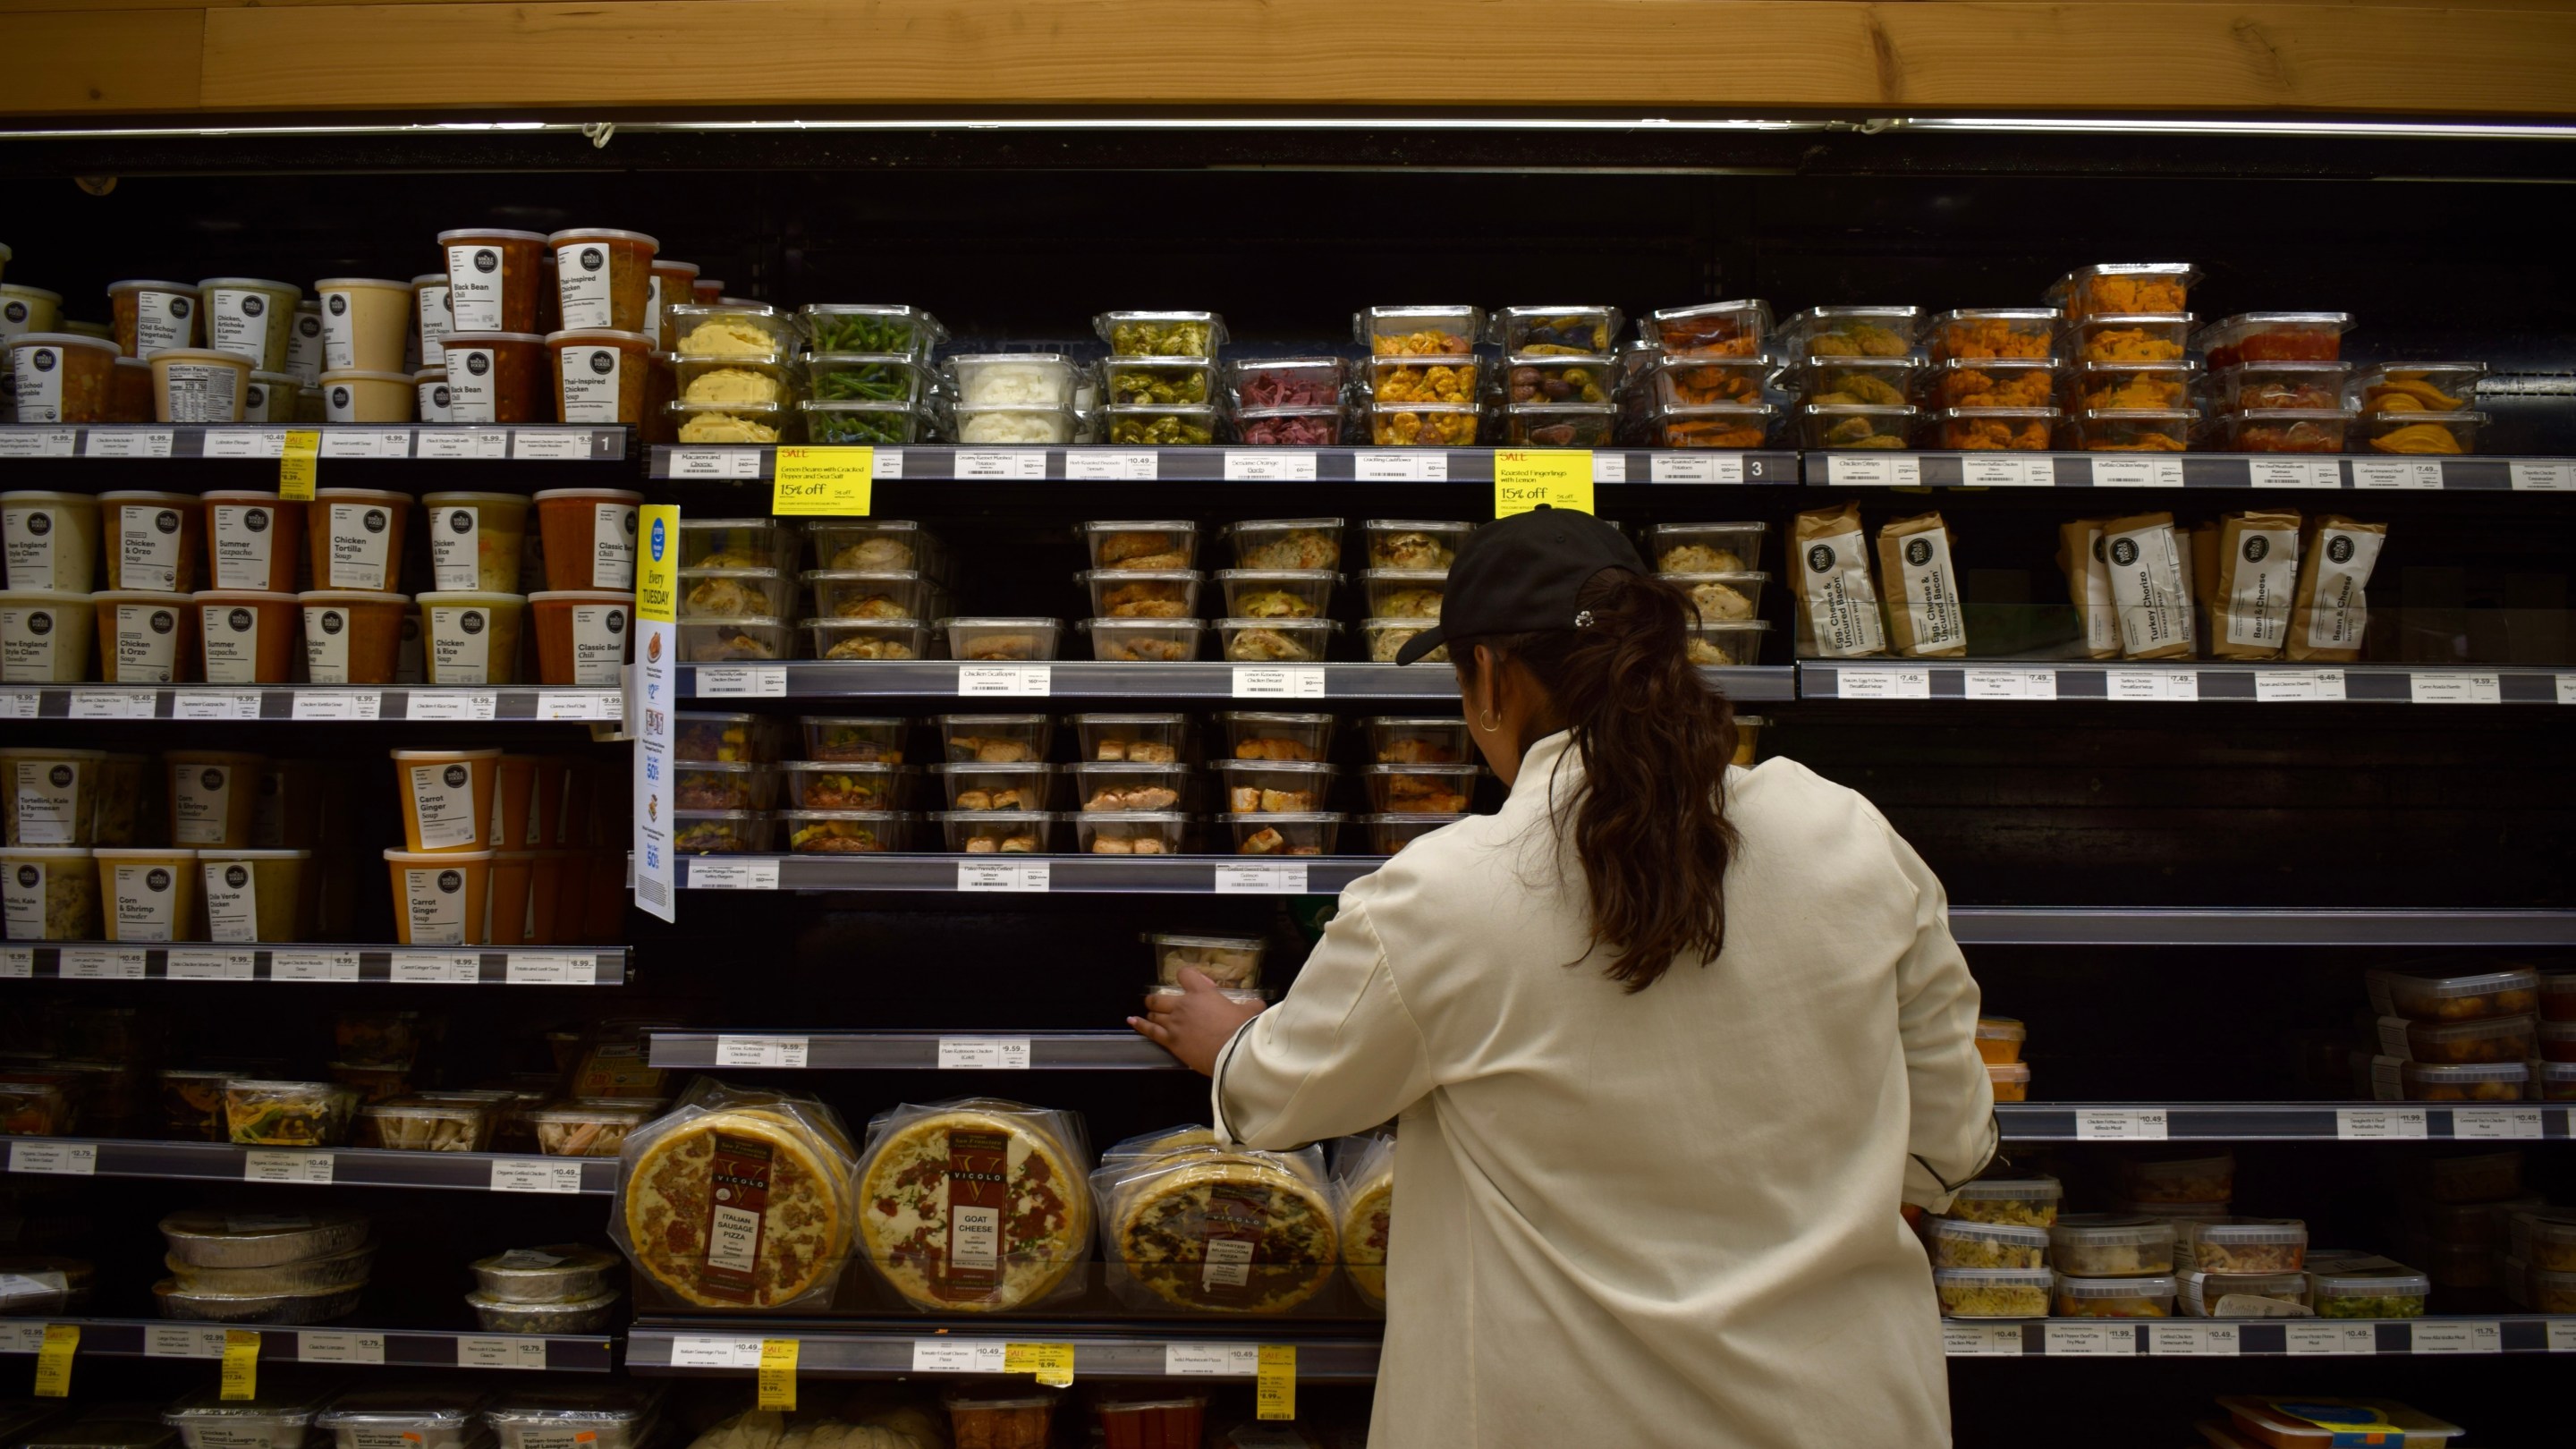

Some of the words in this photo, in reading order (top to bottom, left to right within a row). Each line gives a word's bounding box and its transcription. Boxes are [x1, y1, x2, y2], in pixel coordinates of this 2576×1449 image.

[561, 275, 597, 285] Thai-Inspired
[561, 284, 580, 292] Chicken
[217, 315, 242, 323] Chicken,
[140, 324, 154, 332] Old
[156, 325, 177, 334] School
[140, 331, 174, 340] Vegetable
[564, 378, 606, 386] Thai-Inspired
[602, 436, 609, 451] 1
[782, 449, 809, 458] SALE
[1500, 452, 1528, 462] SALE
[1751, 462, 1763, 476] 3
[781, 473, 801, 481] Pepper
[1530, 470, 1567, 479] Fingerlings
[780, 484, 803, 496] 15%
[805, 484, 826, 496] off
[1501, 487, 1524, 499] 15%
[1528, 487, 1548, 499] off
[125, 539, 156, 547] Chicken
[220, 540, 250, 548] Summer
[335, 536, 367, 545] Chicken
[20, 542, 47, 550] England
[335, 545, 361, 553] Tortilla
[8, 550, 21, 558] Style
[132, 547, 152, 555] Orzo
[220, 548, 253, 557] Gazpacho
[125, 555, 141, 563] Soup
[335, 552, 352, 561] Soup
[648, 570, 665, 589] Every
[2140, 572, 2152, 608] Chorizo
[2257, 572, 2267, 607] Cheese
[2338, 575, 2353, 609] Cheese
[642, 589, 670, 606] TUESDAY
[1924, 586, 1936, 621] Cheese
[1827, 591, 1839, 626] Cheese
[2336, 610, 2343, 618] &
[1938, 600, 1949, 641] Uncured
[1840, 606, 1852, 648] Uncured
[2148, 610, 2159, 642] Turkey
[2253, 616, 2262, 640] Bean
[2333, 619, 2343, 641] Bean
[1931, 623, 1941, 644] Egg,
[436, 639, 465, 647] Chicken
[1835, 628, 1843, 649] Egg,
[120, 640, 150, 648] Chicken
[578, 643, 606, 651] Classic
[606, 643, 622, 651] Beef
[128, 648, 147, 656] Orzo
[120, 655, 136, 663] Soup
[436, 655, 452, 664] Soup
[647, 763, 656, 779] 50
[21, 797, 52, 805] Tortellini,
[419, 794, 444, 802] Carrot
[420, 801, 446, 811] Ginger
[421, 811, 438, 820] Soup
[647, 851, 656, 868] 50
[411, 898, 436, 906] Carrot
[126, 905, 155, 913] Shrimp
[412, 905, 438, 915] Ginger
[413, 914, 429, 923] Soup
[717, 1174, 764, 1188] VICOLO
[954, 1172, 1001, 1181] VICOLO
[722, 1213, 750, 1224] ITALIAN
[964, 1215, 987, 1224] GOAT
[1213, 1216, 1259, 1225] VICOLO
[717, 1221, 753, 1233] SAUSAGE
[959, 1224, 993, 1233] CHEESE
[724, 1232, 745, 1241] PIZZA
